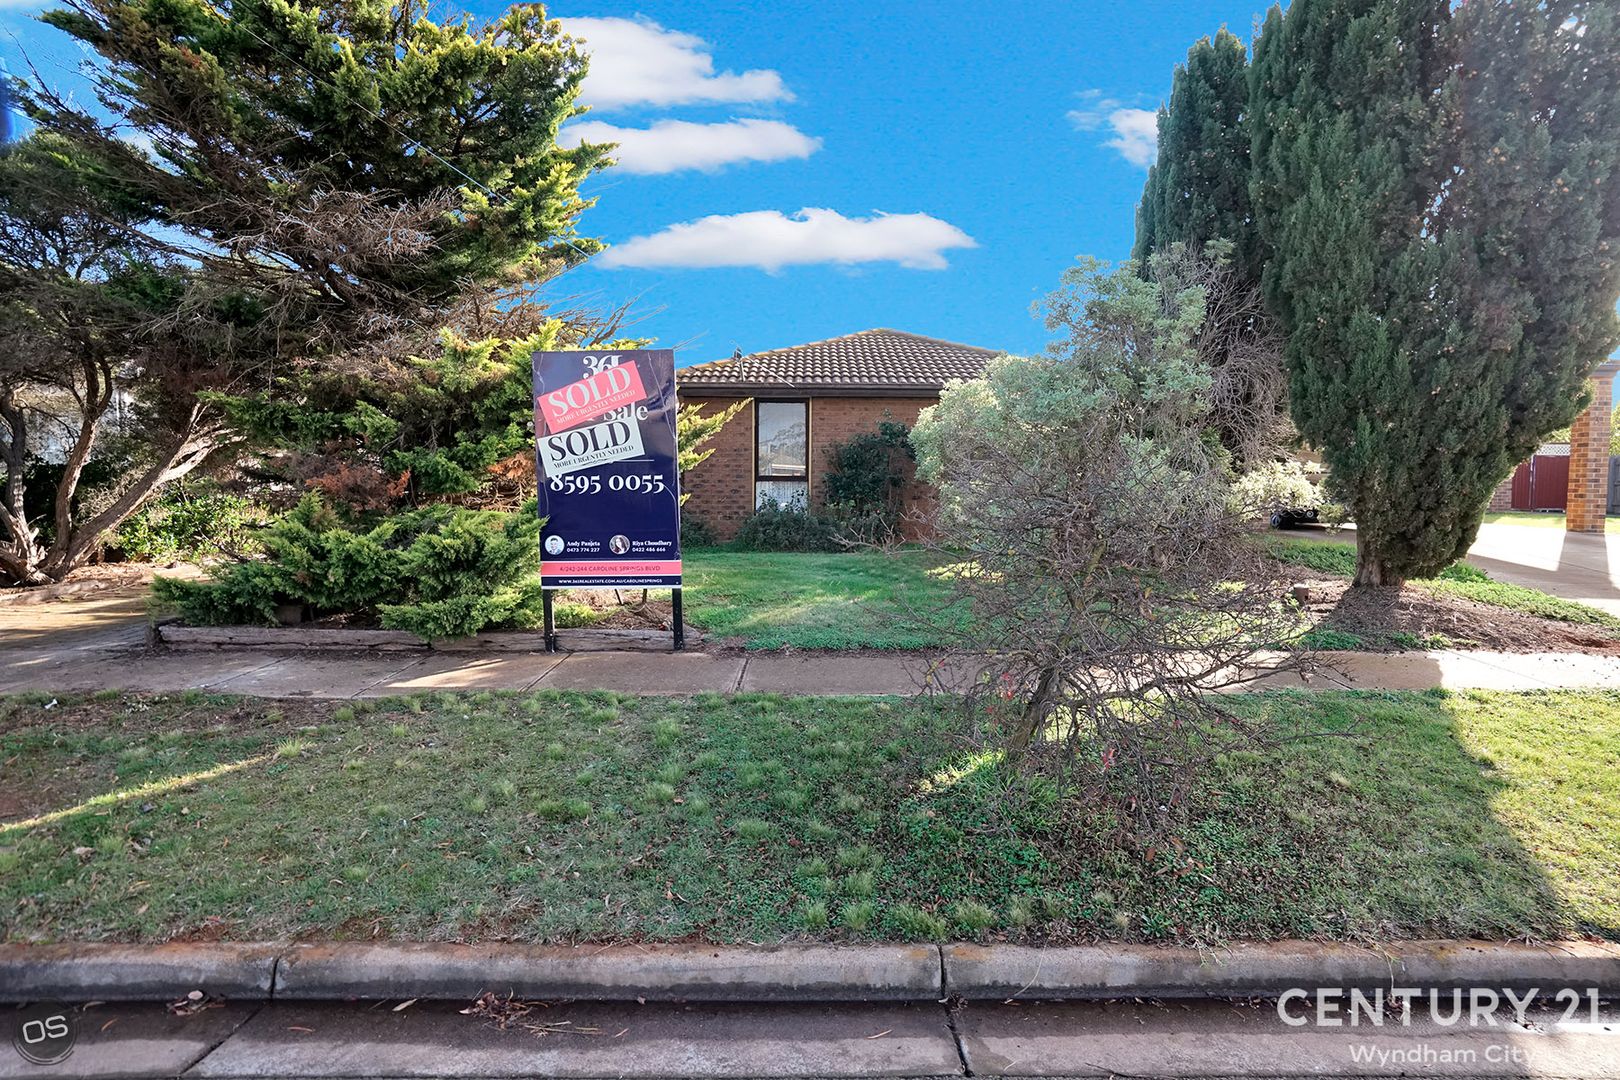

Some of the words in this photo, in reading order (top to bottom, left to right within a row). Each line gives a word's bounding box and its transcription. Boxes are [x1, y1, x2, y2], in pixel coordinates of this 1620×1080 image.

[548, 367, 631, 417] SOLD
[556, 413, 575, 424] MORE
[575, 401, 609, 416] URGENTLY
[609, 390, 636, 403] NEEDED
[548, 421, 631, 461] SOLD
[553, 459, 571, 469] MORE
[573, 451, 607, 464] URGENTLY
[606, 445, 634, 456] NEEDED
[550, 474, 602, 495] 8595
[608, 474, 664, 494] 0055
